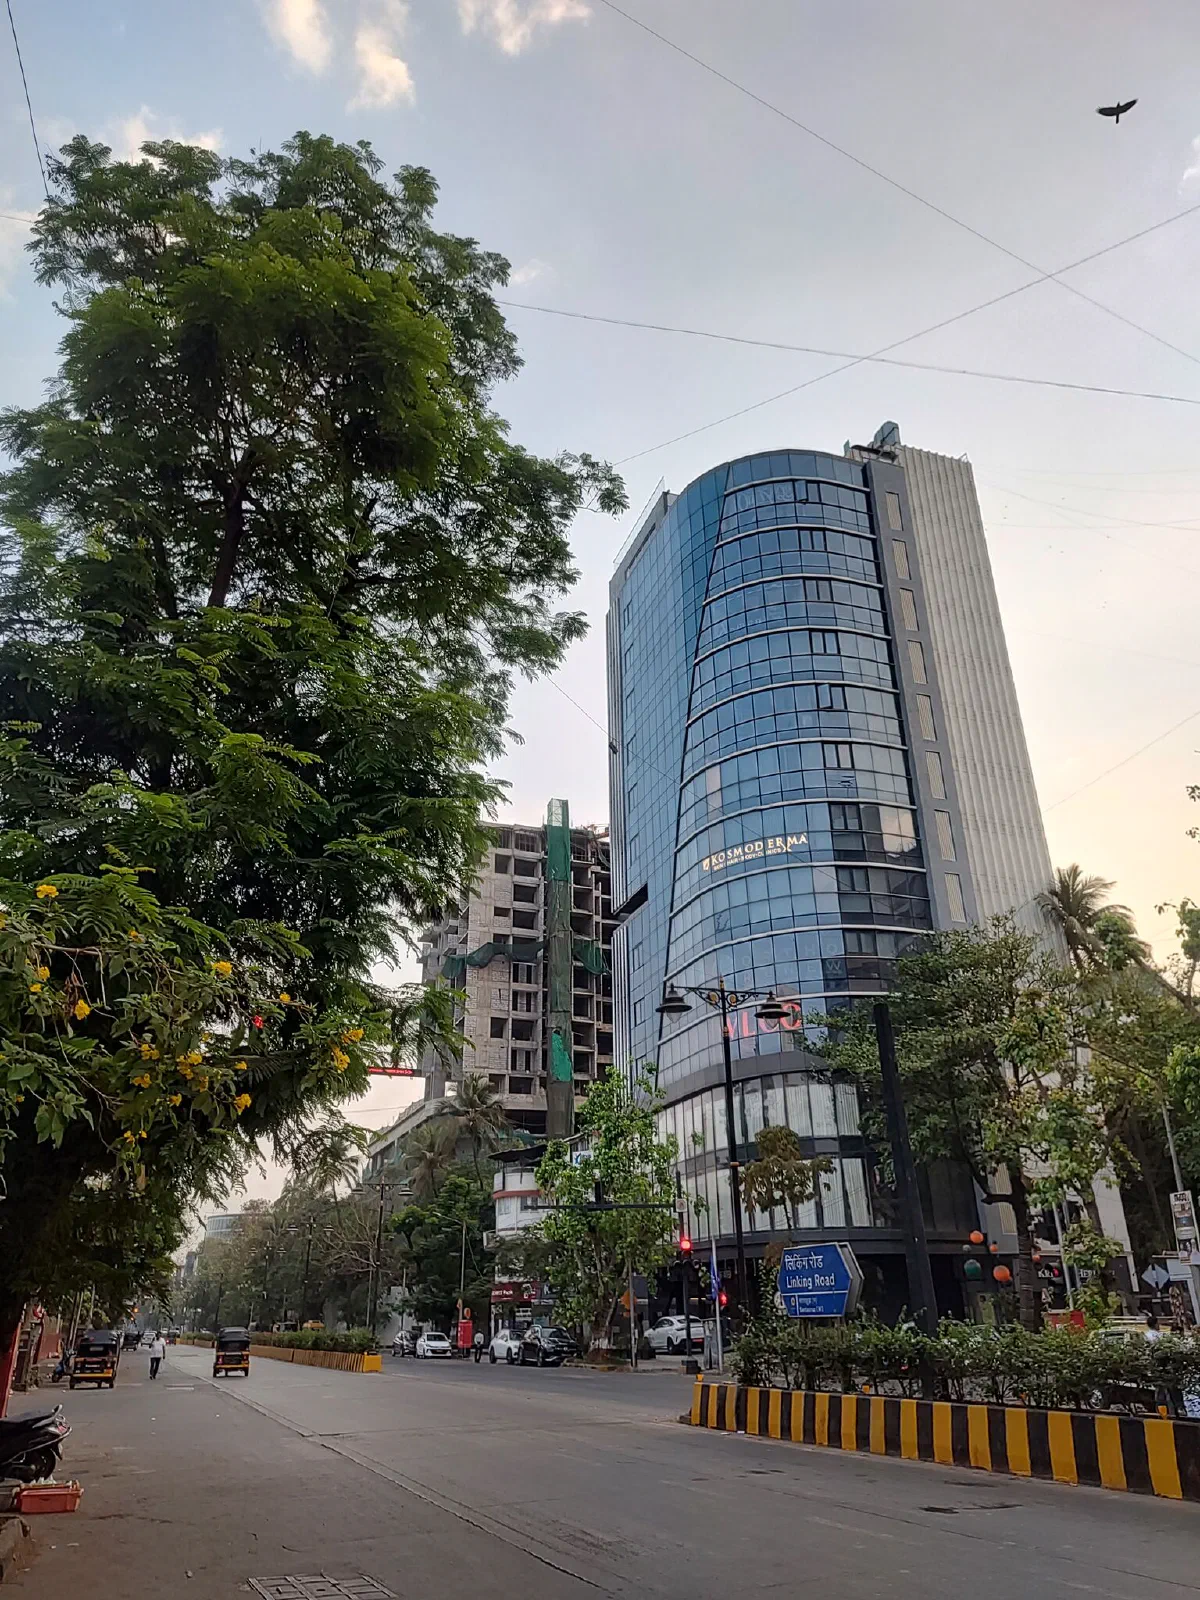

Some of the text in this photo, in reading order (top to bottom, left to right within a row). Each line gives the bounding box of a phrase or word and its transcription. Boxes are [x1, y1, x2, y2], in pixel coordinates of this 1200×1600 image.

[711, 833, 809, 866] KOSMODERMA
[809, 1251, 823, 1268] रोड
[786, 1273, 834, 1289] Linking Road
